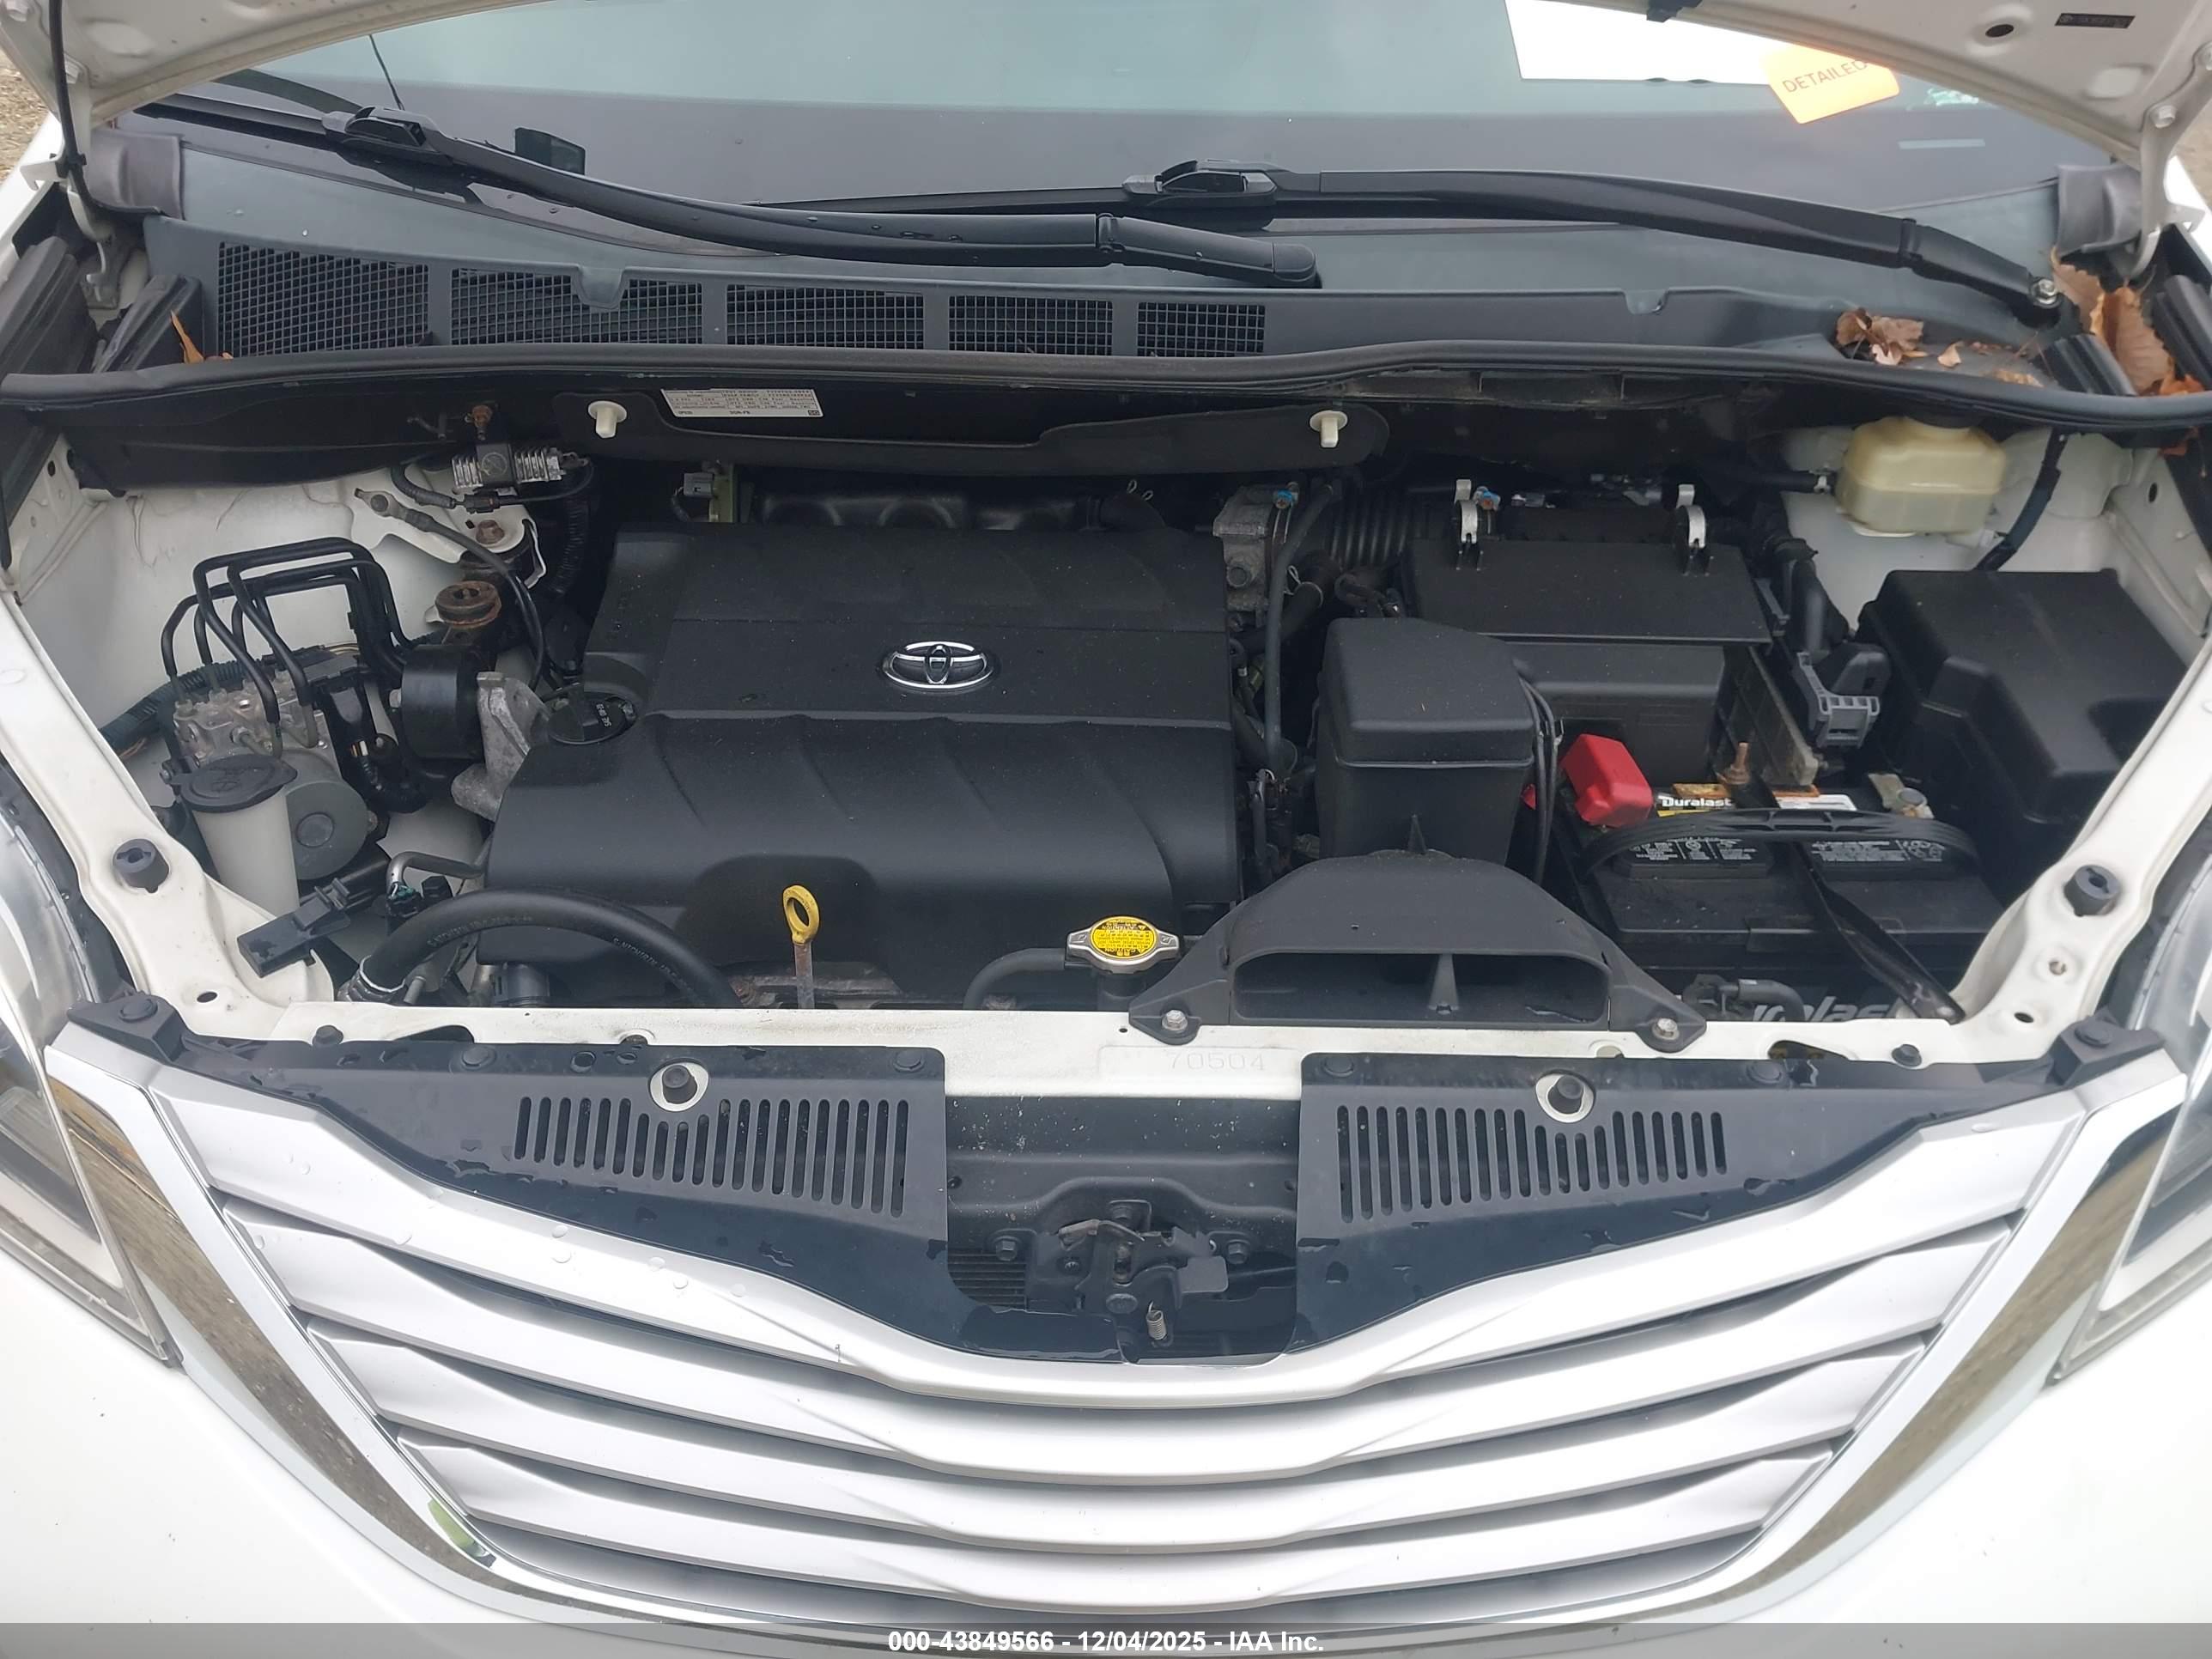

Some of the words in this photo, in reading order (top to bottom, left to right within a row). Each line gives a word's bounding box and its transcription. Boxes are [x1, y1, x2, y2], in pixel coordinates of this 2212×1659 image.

[1782, 60, 1868, 93] DETAILED
[1657, 795, 1732, 807] Duralast
[1167, 1051, 1266, 1071] 70504
